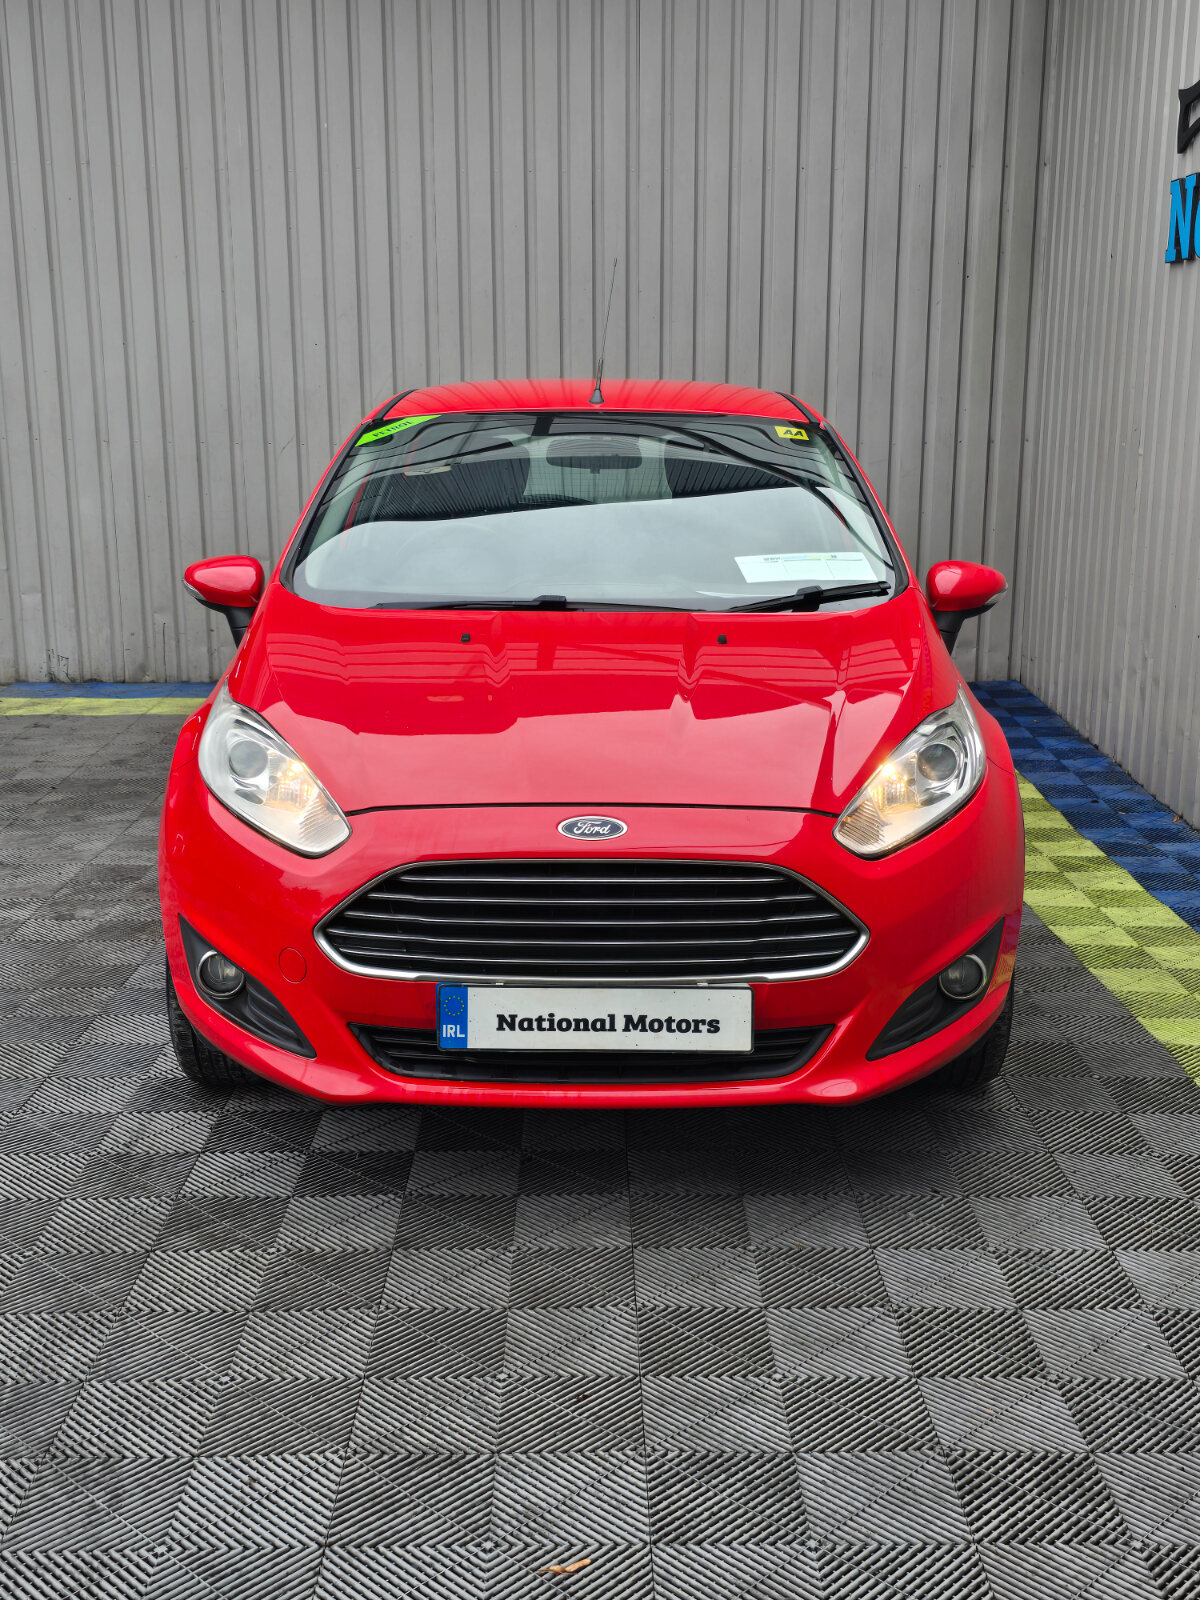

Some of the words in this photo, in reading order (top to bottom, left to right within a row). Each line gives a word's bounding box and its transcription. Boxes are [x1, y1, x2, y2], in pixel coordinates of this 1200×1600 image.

[783, 429, 804, 437] AA
[573, 821, 611, 834] Ford
[496, 1013, 617, 1033] National
[622, 1014, 721, 1034] Motors
[442, 1024, 465, 1038] IRL
